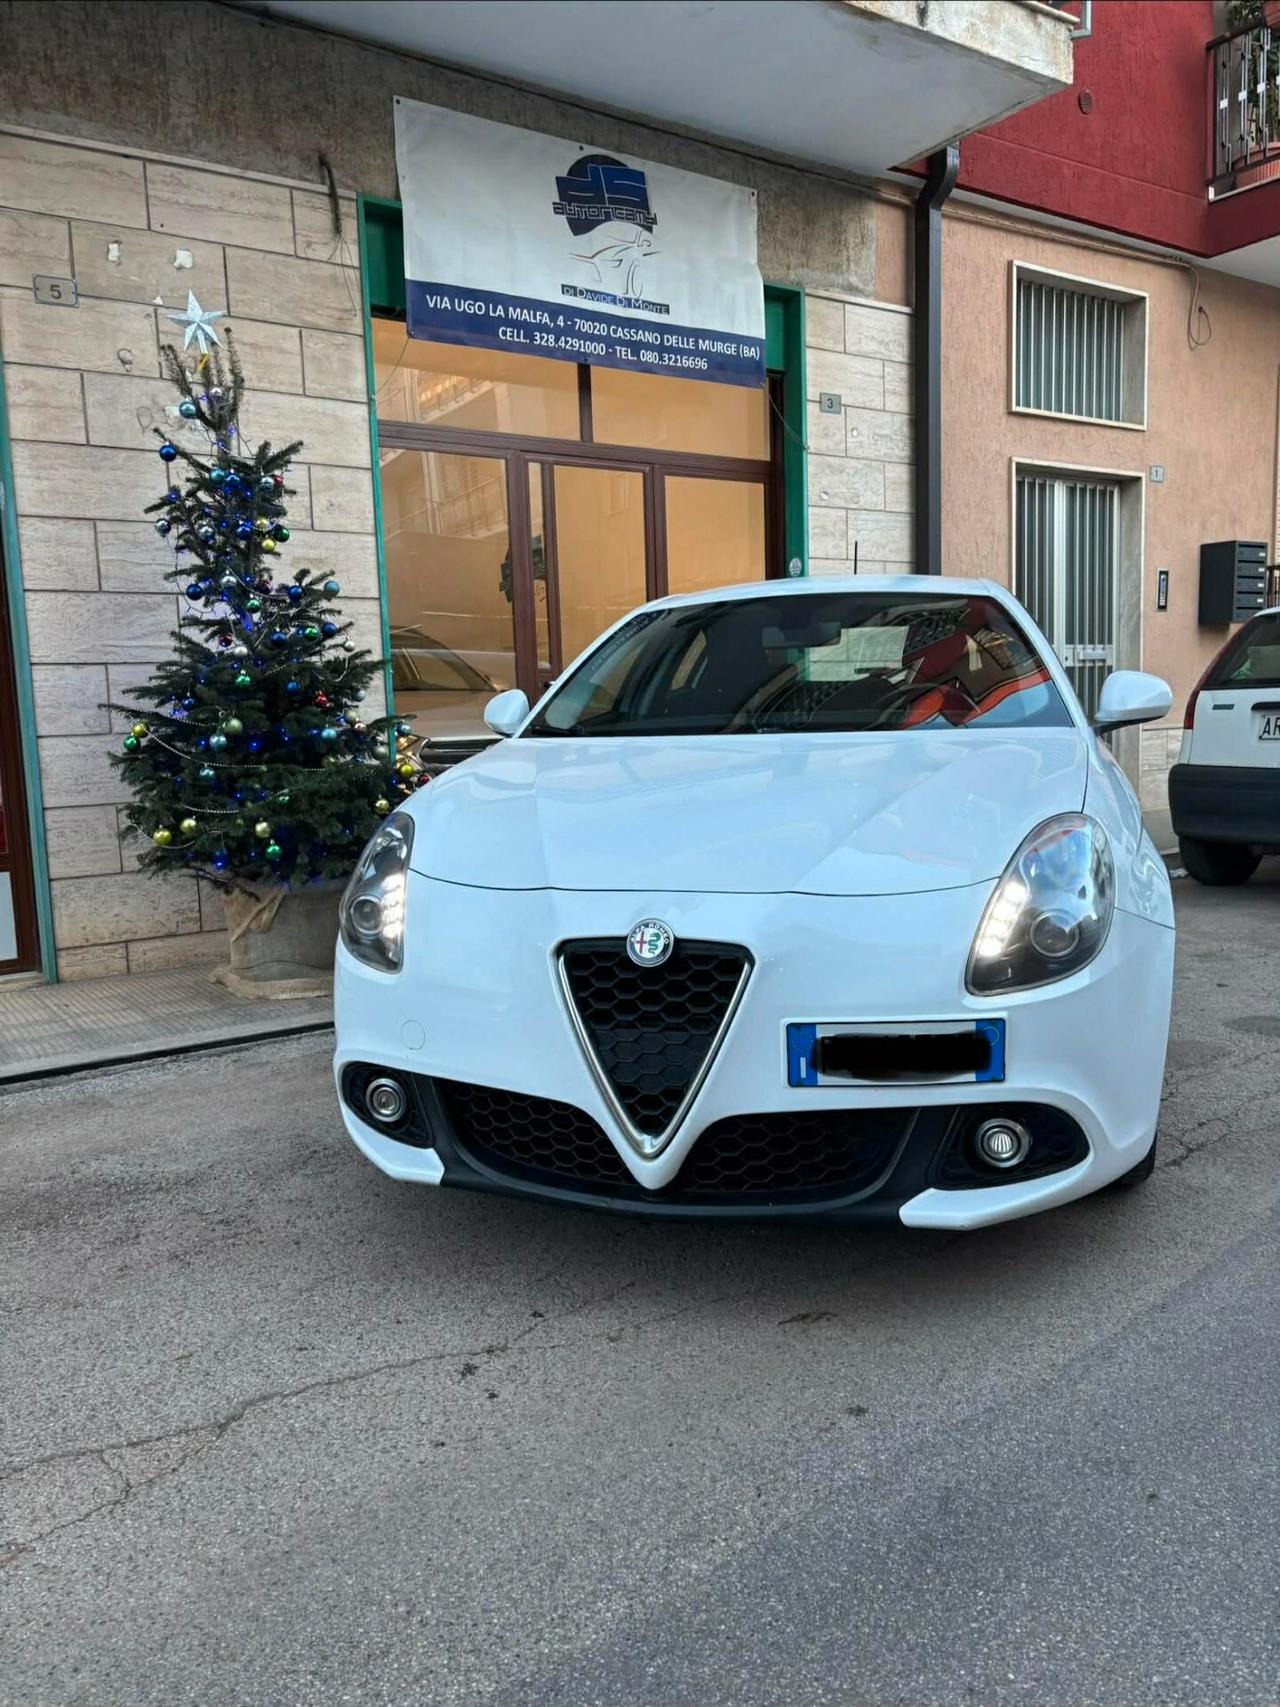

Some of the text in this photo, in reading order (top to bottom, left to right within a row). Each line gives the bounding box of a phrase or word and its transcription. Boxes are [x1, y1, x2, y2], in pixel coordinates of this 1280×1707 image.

[50, 284, 62, 299] 5
[426, 294, 451, 311] VIA
[454, 300, 486, 315] UGO
[489, 304, 505, 318] LA
[508, 307, 554, 328] MALFA,
[556, 315, 564, 328] 4
[574, 318, 608, 335] 70020
[609, 325, 661, 345] CASSANO
[664, 334, 695, 349] DELLE
[698, 338, 737, 356] MURGE
[739, 344, 760, 361] (BA)
[498, 326, 530, 343] CELL.
[533, 332, 606, 356] 328.4291000
[615, 346, 637, 360] TEL.
[640, 350, 708, 370] 080.3216696
[827, 398, 833, 409] 3
